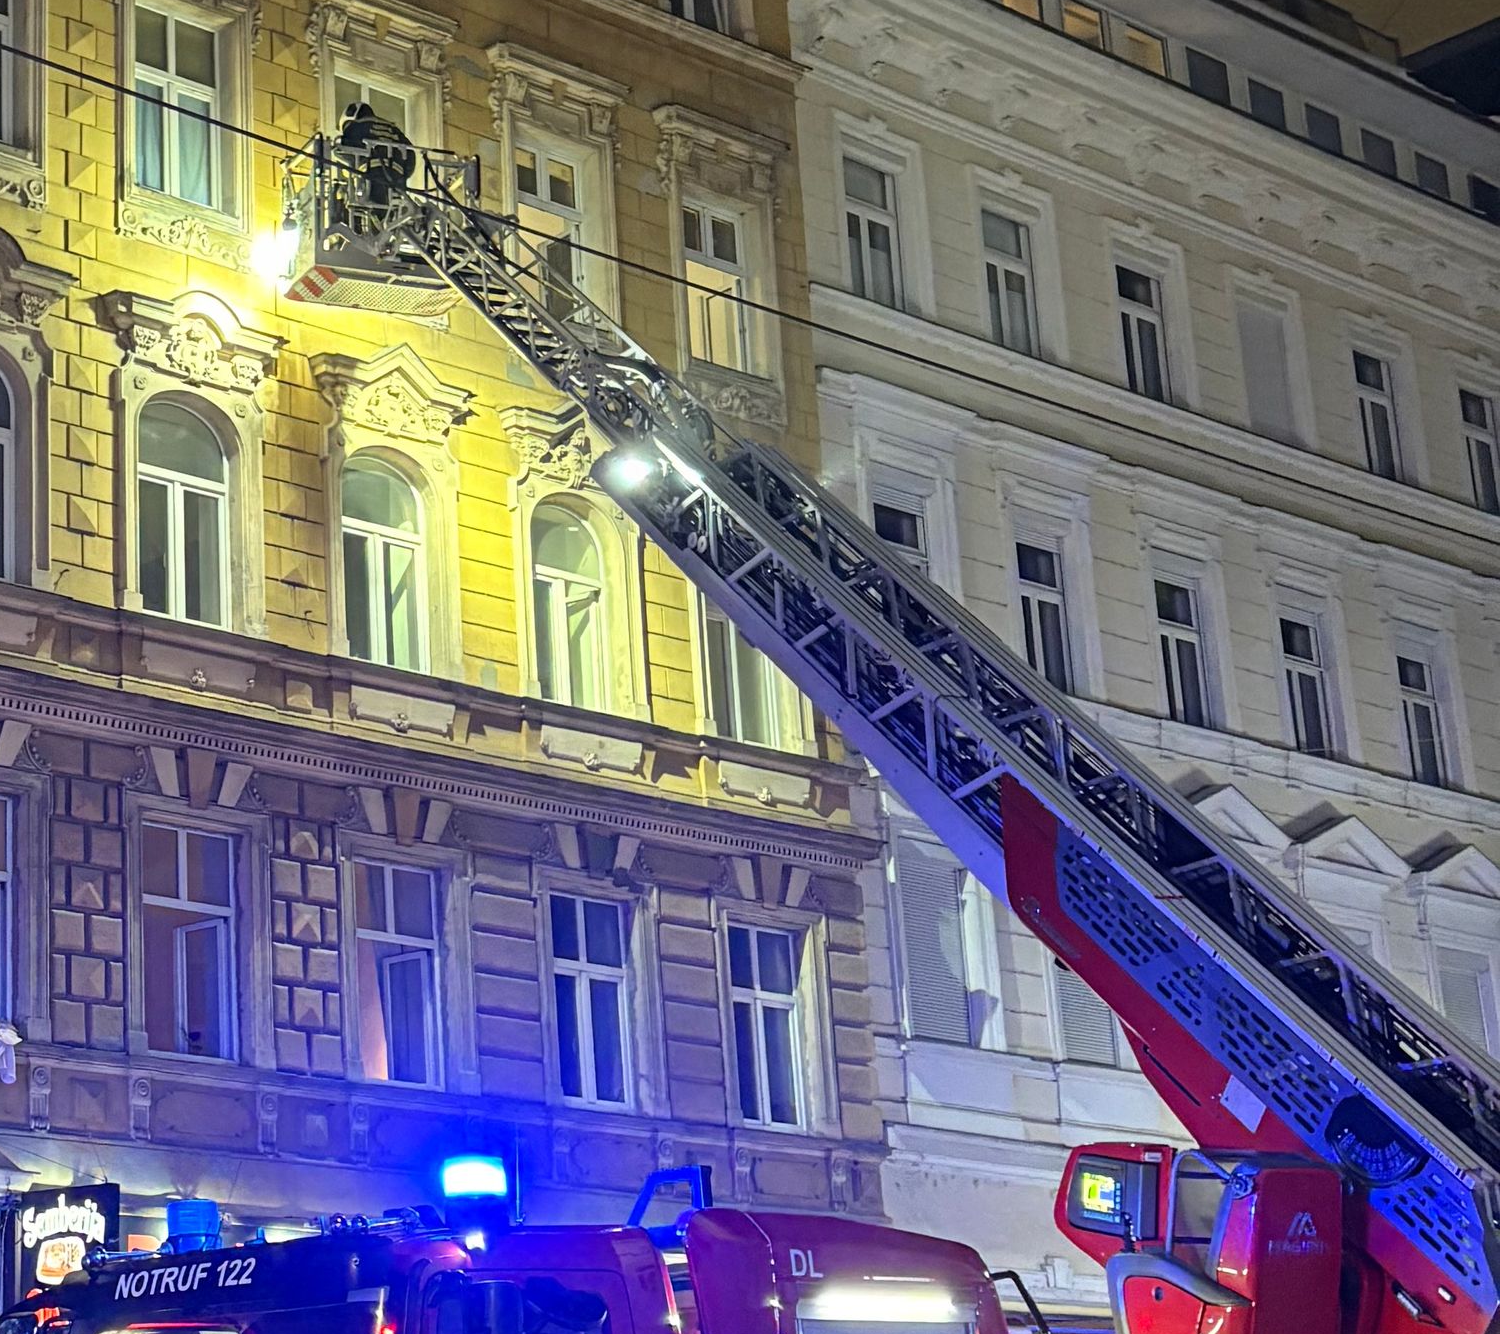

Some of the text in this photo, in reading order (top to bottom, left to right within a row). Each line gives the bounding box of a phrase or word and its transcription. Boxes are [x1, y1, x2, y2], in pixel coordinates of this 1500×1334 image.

[114, 1257, 256, 1300] NOTRUF 122
[789, 1248, 824, 1278] DL
